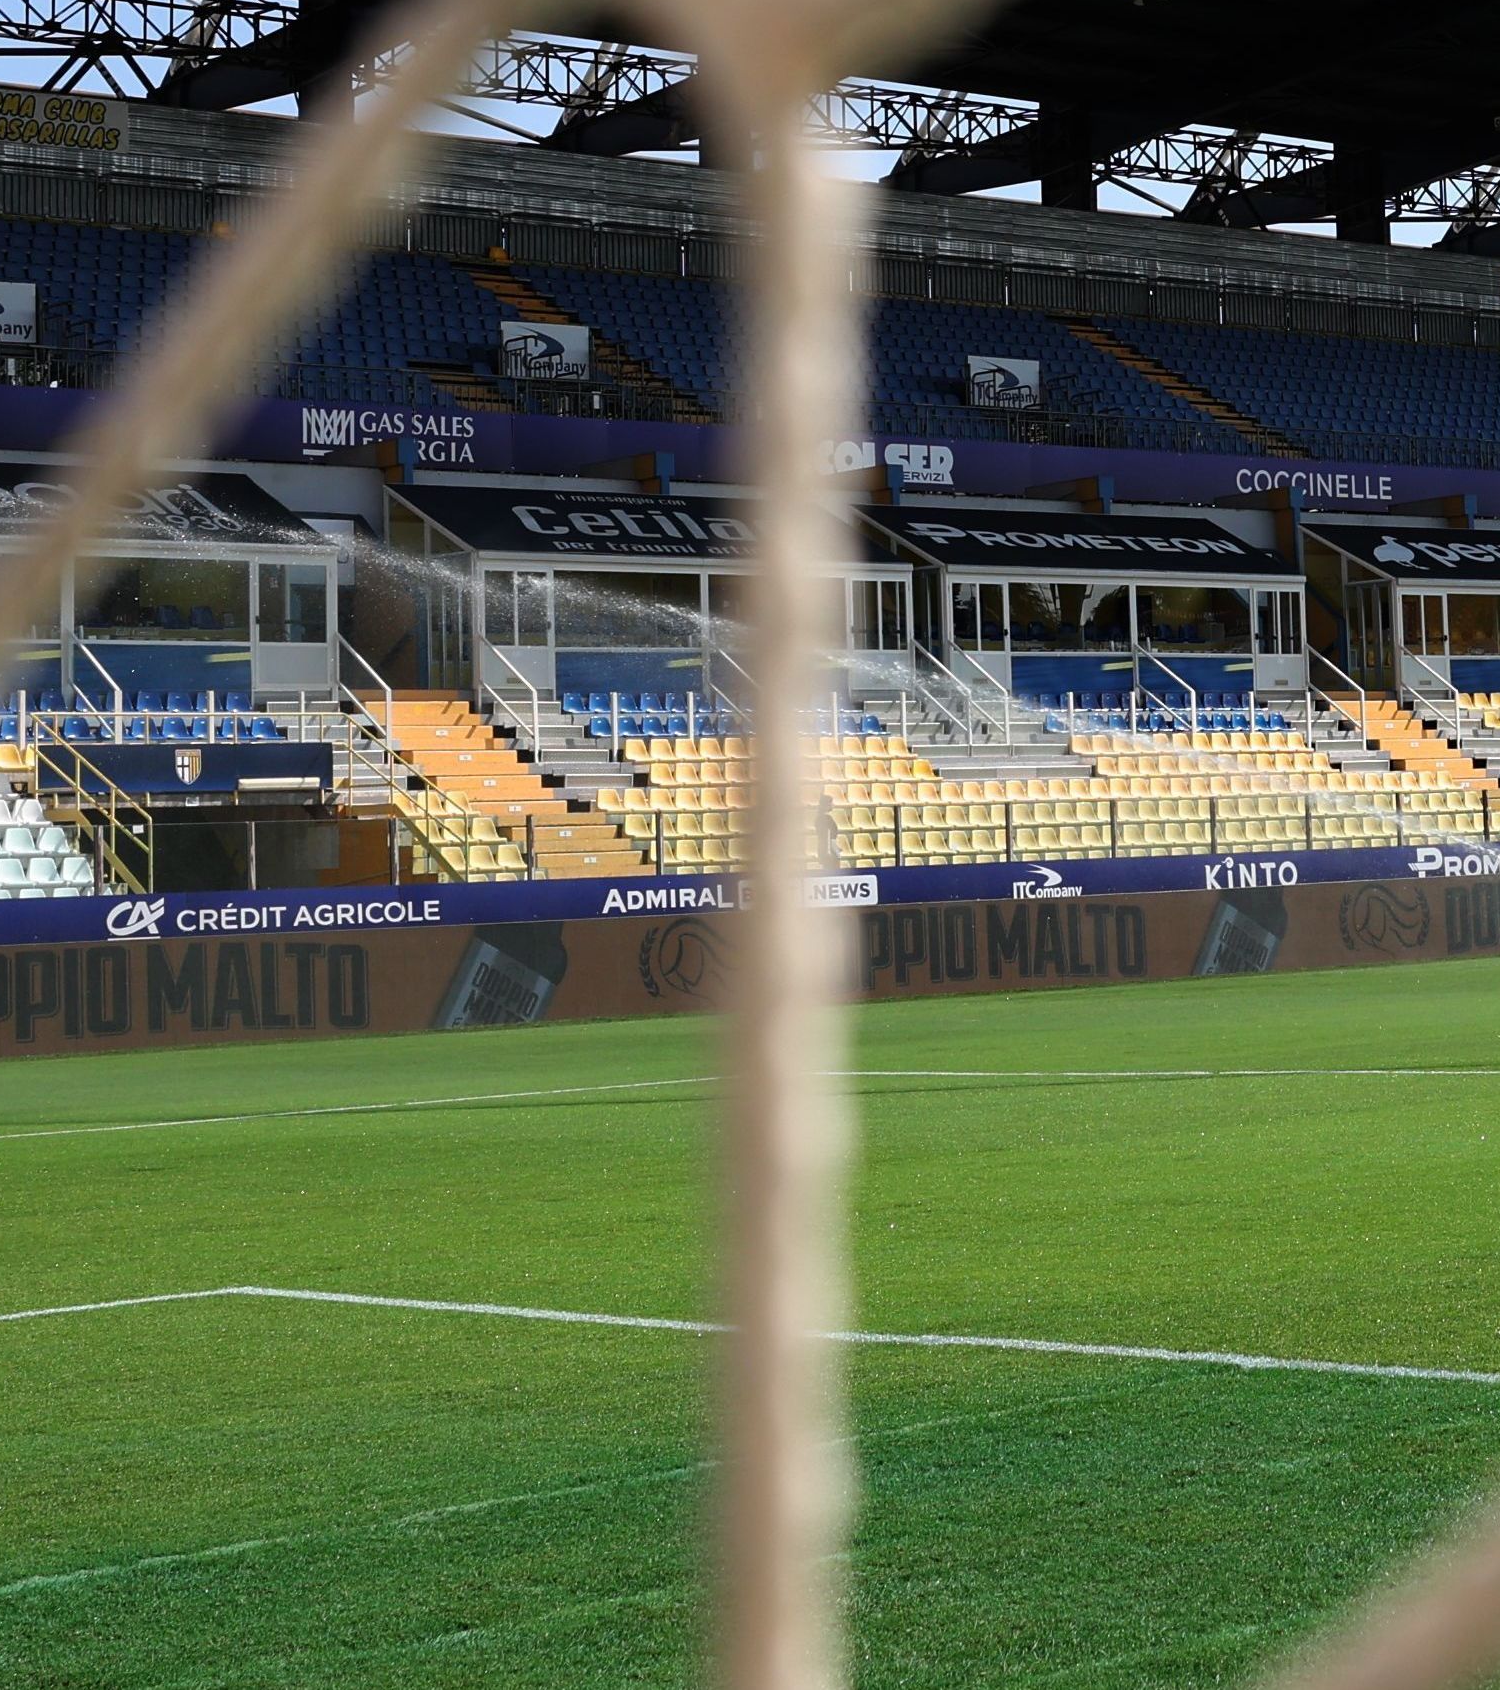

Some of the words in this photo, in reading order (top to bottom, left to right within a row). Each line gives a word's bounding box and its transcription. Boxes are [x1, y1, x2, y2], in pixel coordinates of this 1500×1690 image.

[44, 95, 106, 124] CLUB
[359, 410, 405, 435] GAS
[411, 414, 475, 438] SALES
[902, 471, 945, 483] ERVIZI
[1236, 467, 1393, 500] COCCINELLE
[658, 497, 687, 507] con
[511, 505, 760, 542] Cetila
[906, 522, 1247, 555] PROMETEON
[608, 541, 697, 555] traumi
[602, 884, 734, 914] ADMIRAL
[175, 902, 287, 932] CRÉDIT
[293, 899, 441, 928] AGRICOLE
[987, 904, 1147, 979] MALTO
[145, 941, 370, 1034] MALTO
